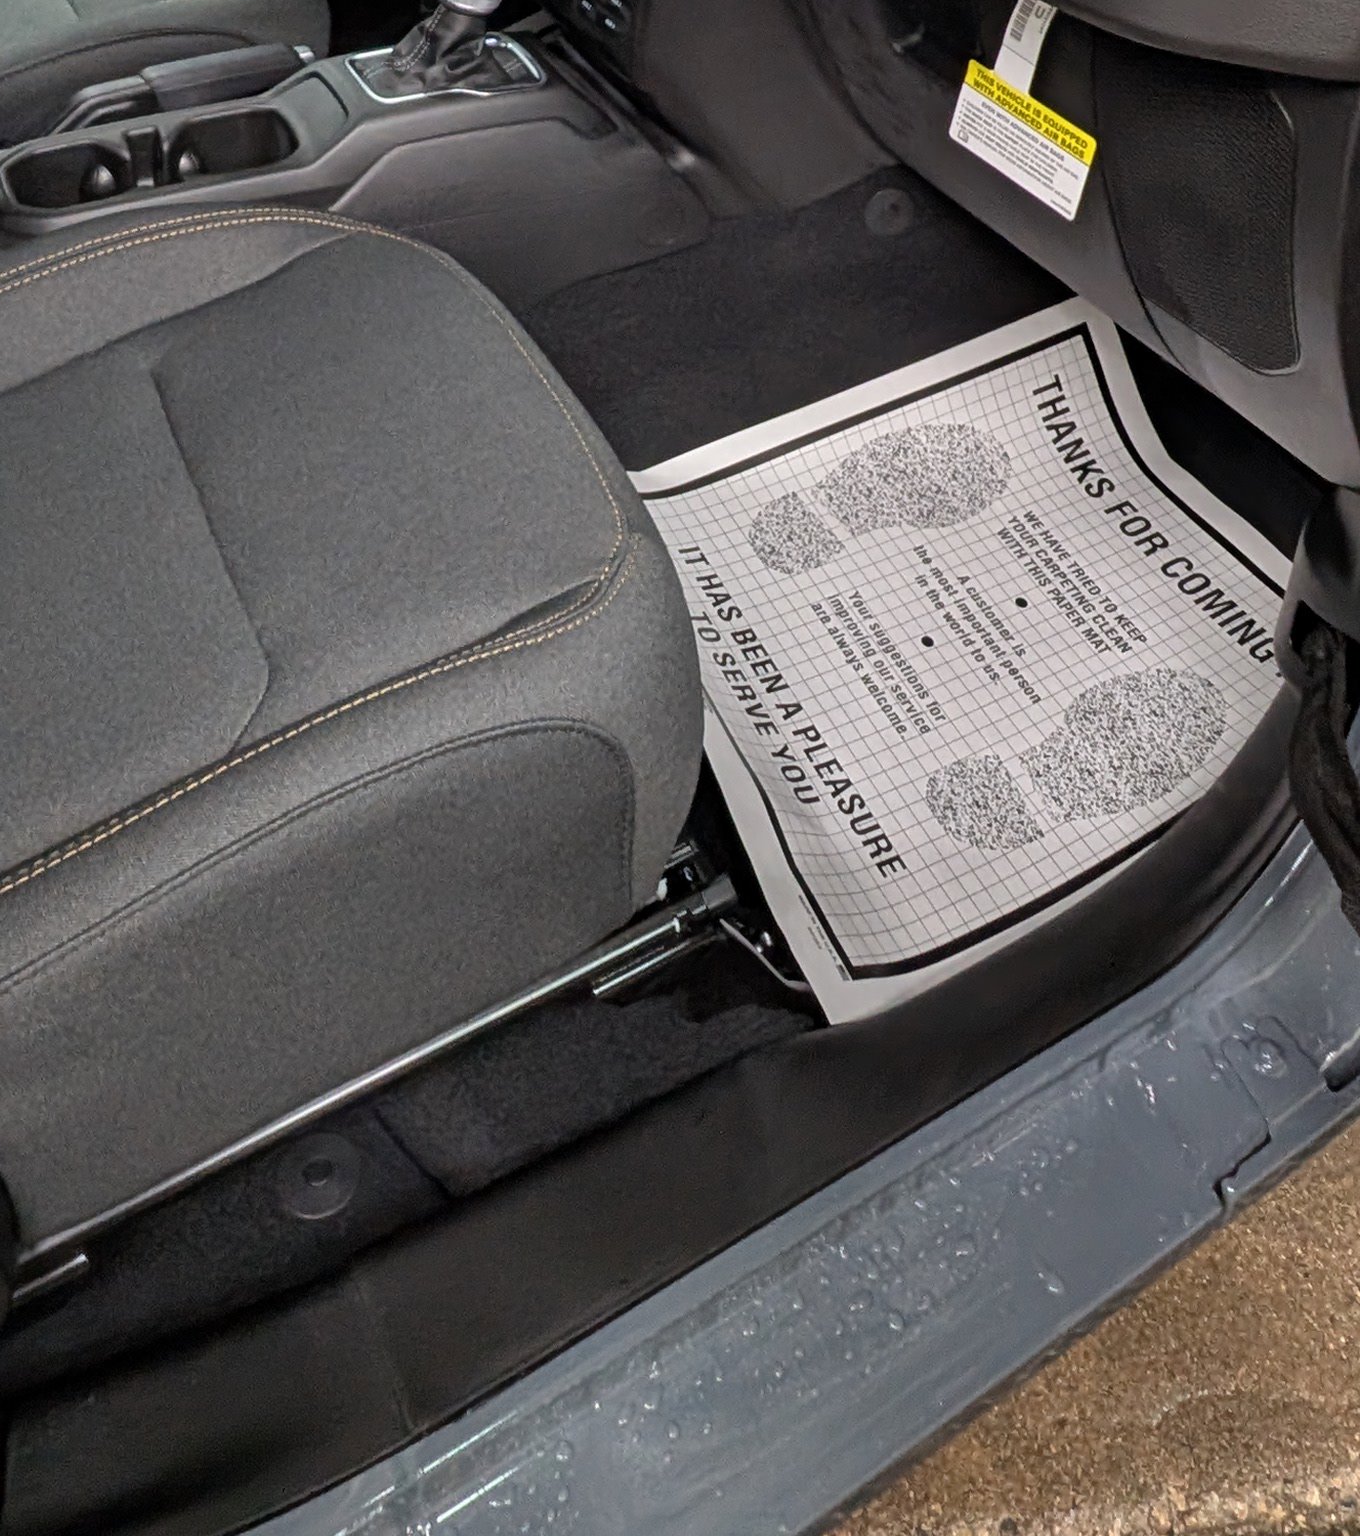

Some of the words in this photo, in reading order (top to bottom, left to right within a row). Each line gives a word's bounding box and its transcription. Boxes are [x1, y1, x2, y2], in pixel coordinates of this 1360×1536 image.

[972, 78, 996, 98] WITH
[995, 95, 1043, 131] ADVANCED
[1043, 124, 1060, 143] AIR
[1060, 137, 1086, 160] BAGS
[976, 69, 995, 86] THIS
[995, 81, 1033, 113] VEHICLE
[1032, 107, 1043, 119] IS
[1043, 113, 1089, 150] EQUIPPED
[1008, 515, 1039, 548] YOUR
[1035, 549, 1096, 615] CARPETING
[1092, 614, 1133, 654] CLEAN
[1023, 510, 1045, 530] WE
[1039, 528, 1071, 561] HAVE
[1067, 560, 1102, 597] TRIED
[1099, 595, 1118, 614] TO
[1114, 614, 1148, 644] KEEP
[1032, 374, 1116, 499] THANKS
[1104, 500, 1169, 558] FOR
[1161, 556, 1275, 664] COMING
[848, 590, 874, 620] Your
[869, 622, 930, 700] suggestions
[925, 700, 947, 722] for
[913, 544, 933, 565] the
[929, 566, 959, 597] most
[953, 597, 1007, 659] important
[999, 659, 1042, 705] person
[914, 574, 929, 589] in
[925, 588, 945, 610] the
[942, 611, 977, 648] world
[970, 647, 986, 663] to
[957, 574, 971, 586] A
[965, 586, 1015, 643] customer
[1011, 642, 1027, 658] is
[997, 527, 1027, 559] WITH
[1023, 558, 1053, 587] THIS
[1047, 587, 1086, 628] PAPER
[1081, 628, 1112, 654] MAT
[677, 545, 711, 567] IT
[695, 573, 744, 623] HAS
[729, 627, 791, 695] BEEN
[774, 701, 802, 722] A
[791, 727, 908, 879] PLEASURE
[689, 613, 721, 644] TO
[712, 652, 780, 738] SERVE
[770, 745, 822, 807] YOU
[811, 602, 832, 625] are
[827, 625, 865, 672] always
[860, 672, 909, 740] welcome.
[827, 593, 877, 658] improving
[873, 659, 896, 683] our
[890, 683, 932, 734] service
